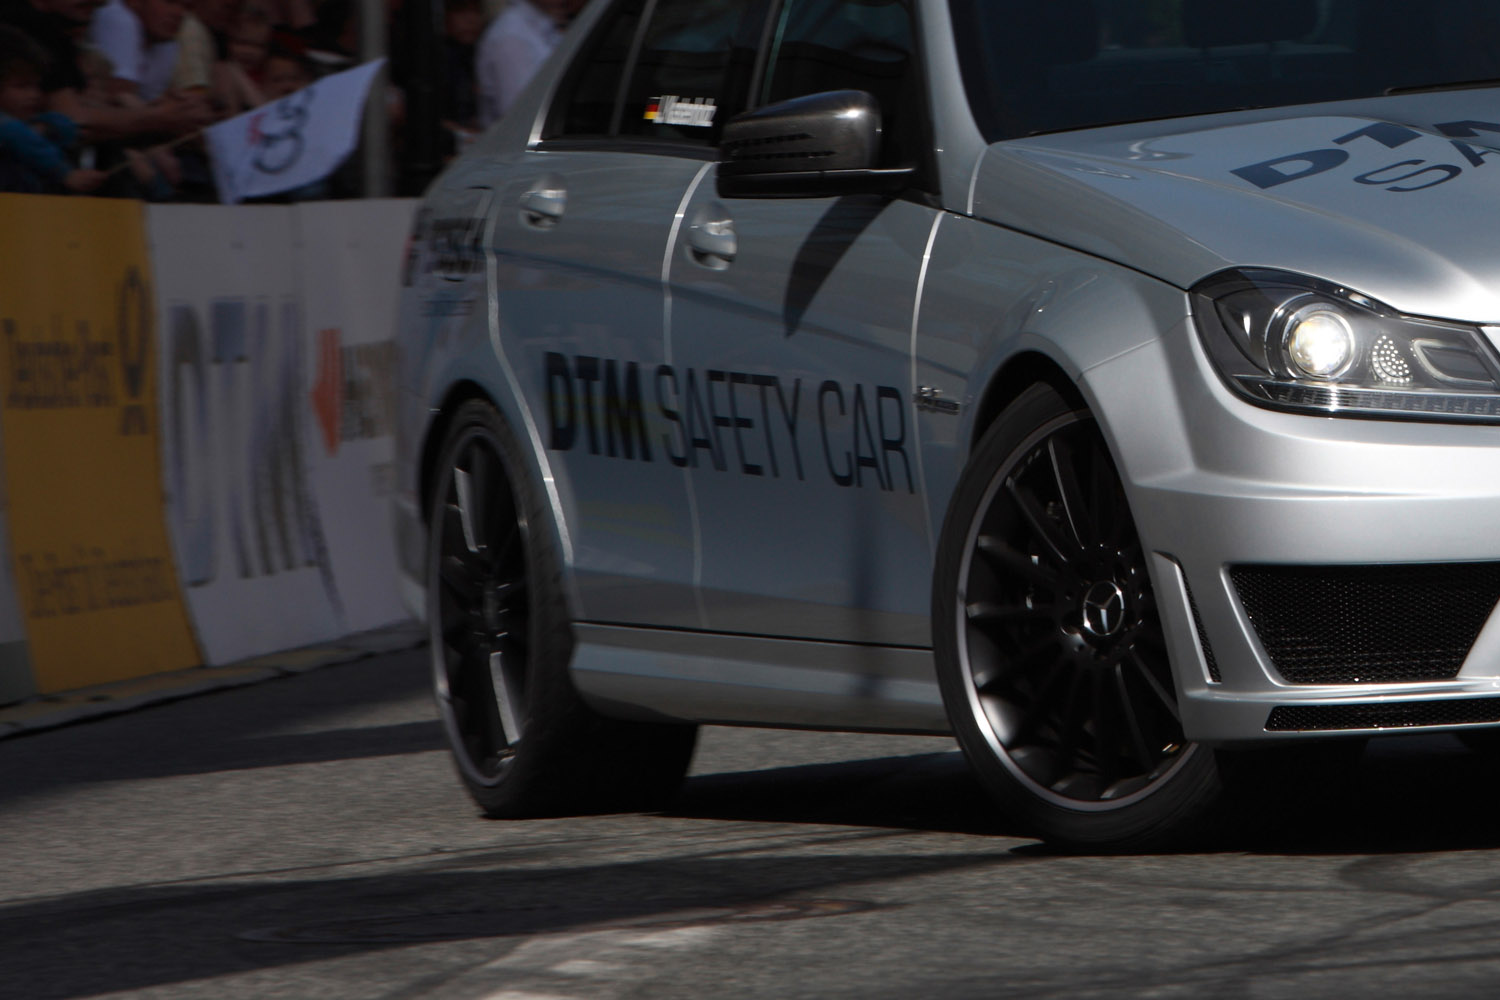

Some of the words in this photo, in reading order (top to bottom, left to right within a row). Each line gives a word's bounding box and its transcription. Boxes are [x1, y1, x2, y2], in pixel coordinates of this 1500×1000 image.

[543, 351, 655, 463] DTM
[655, 364, 805, 482] SAFETY
[817, 380, 915, 495] CAR
